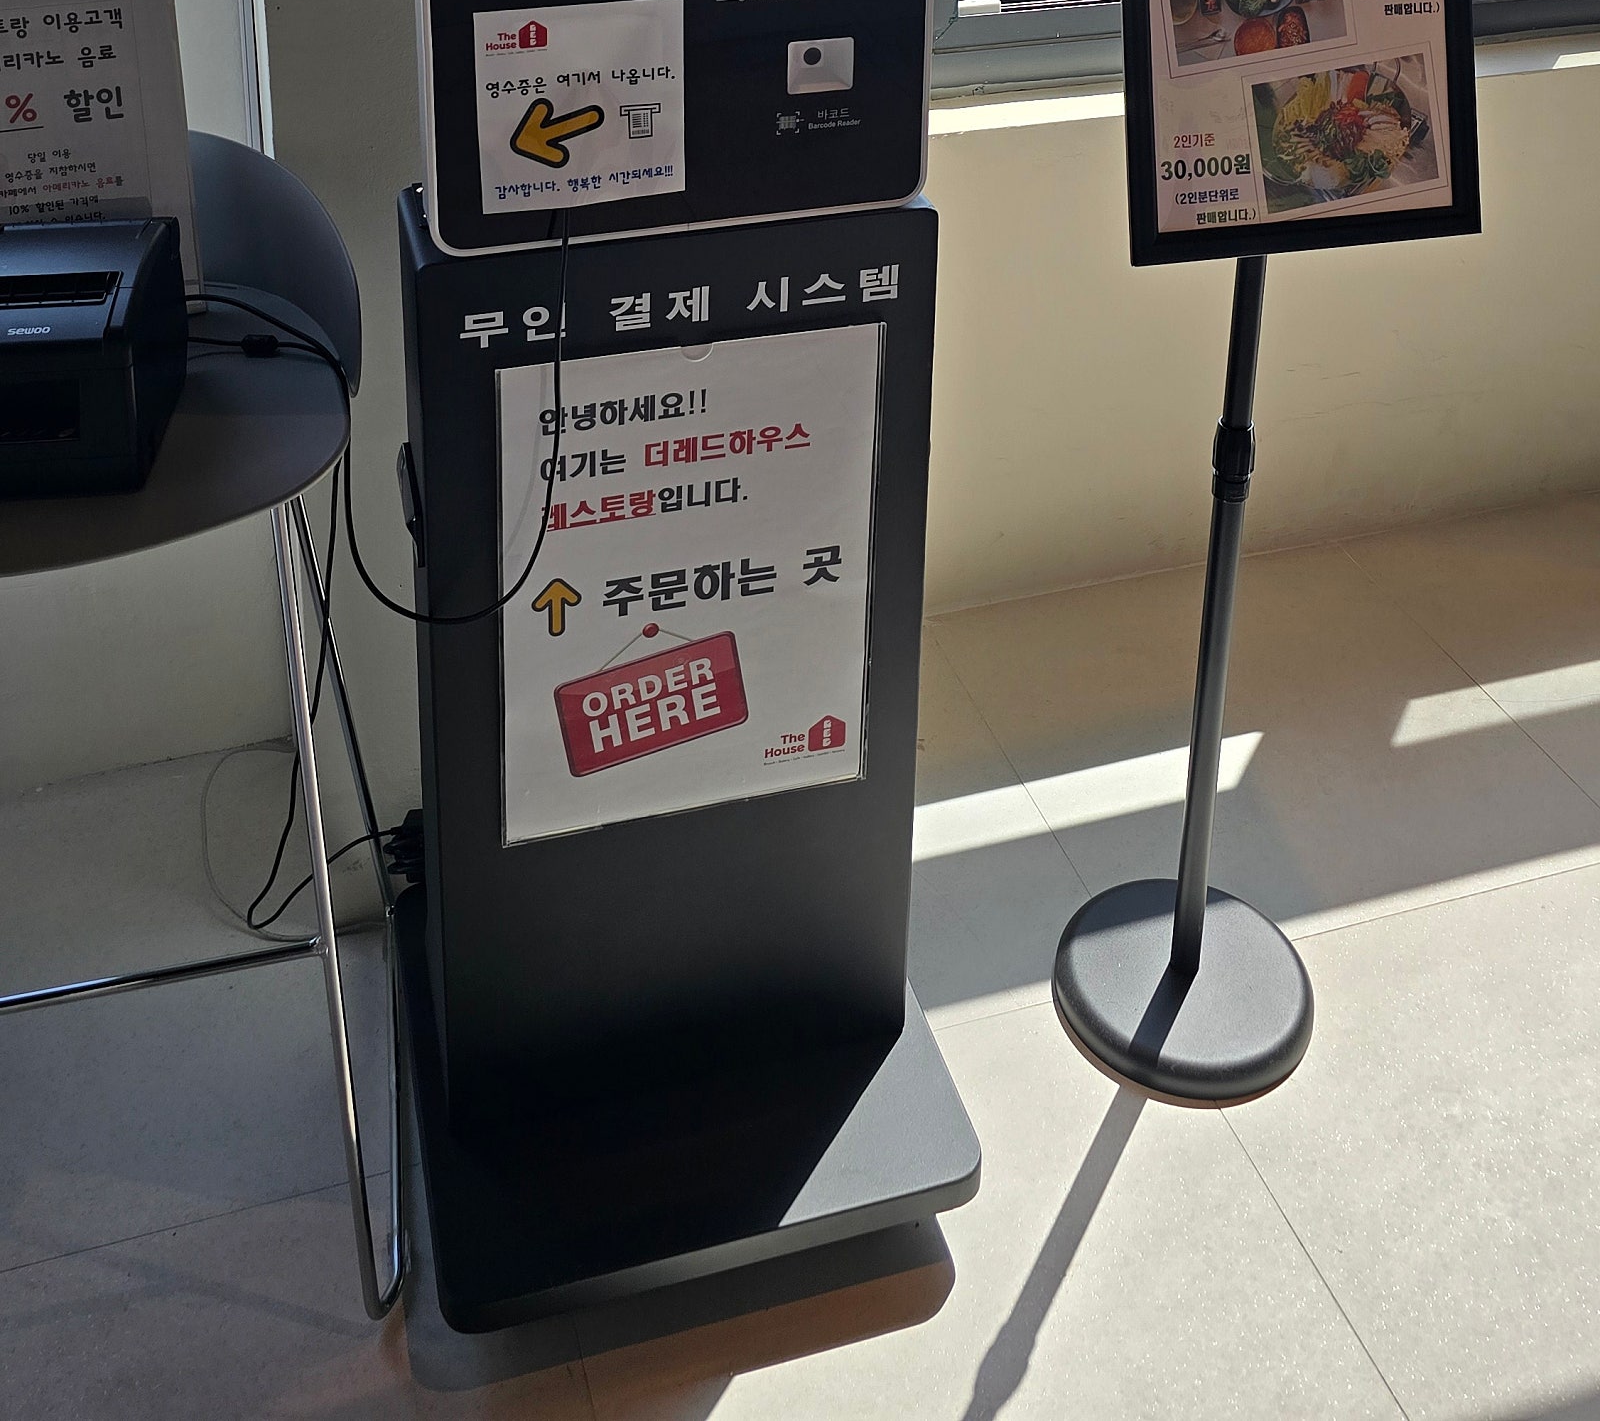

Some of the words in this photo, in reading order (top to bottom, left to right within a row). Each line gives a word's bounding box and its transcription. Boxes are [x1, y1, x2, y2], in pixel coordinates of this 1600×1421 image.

[1384, 1, 1440, 16] 판매합니다.)
[43, 8, 123, 33] 이용고객
[485, 42, 517, 51] House
[497, 32, 517, 41] The
[77, 45, 117, 68] 음료
[485, 77, 547, 99] 영수증은
[556, 70, 601, 87] 여기서
[611, 66, 676, 85] 나옵니다.
[63, 86, 124, 123] 할인
[817, 107, 850, 120] 바코드
[808, 121, 836, 130] Barcode
[837, 119, 861, 127] Reader
[1173, 133, 1215, 149] 2인기준
[27, 151, 46, 164] 당일
[52, 148, 71, 159] 이용
[5, 168, 43, 183] 영수증을
[49, 162, 97, 177] 지참하시면
[1160, 153, 1251, 181] 30,000원
[42, 180, 90, 192] 아메리카노
[495, 181, 561, 199] 감사합니다.
[567, 176, 601, 193] 행복한
[609, 165, 674, 184] 시간되세요!!!
[9, 204, 30, 216] 10%
[35, 200, 65, 213] 할인된
[70, 195, 99, 207] 가격에
[1175, 188, 1240, 205] (2인분단위로
[1196, 208, 1256, 225] 판매합니다.)
[460, 302, 566, 349] 무인
[609, 285, 710, 332] 결제
[747, 264, 900, 312] 시스템
[539, 389, 707, 436] 안녕하세요!!
[540, 449, 627, 482] 여기는
[644, 423, 811, 467] 더레드하우스
[602, 557, 777, 617] 주문하는
[802, 545, 842, 586] 곳
[581, 656, 716, 718] ORDER
[588, 683, 721, 754] HERE
[780, 733, 805, 744] The
[764, 744, 805, 759] House
